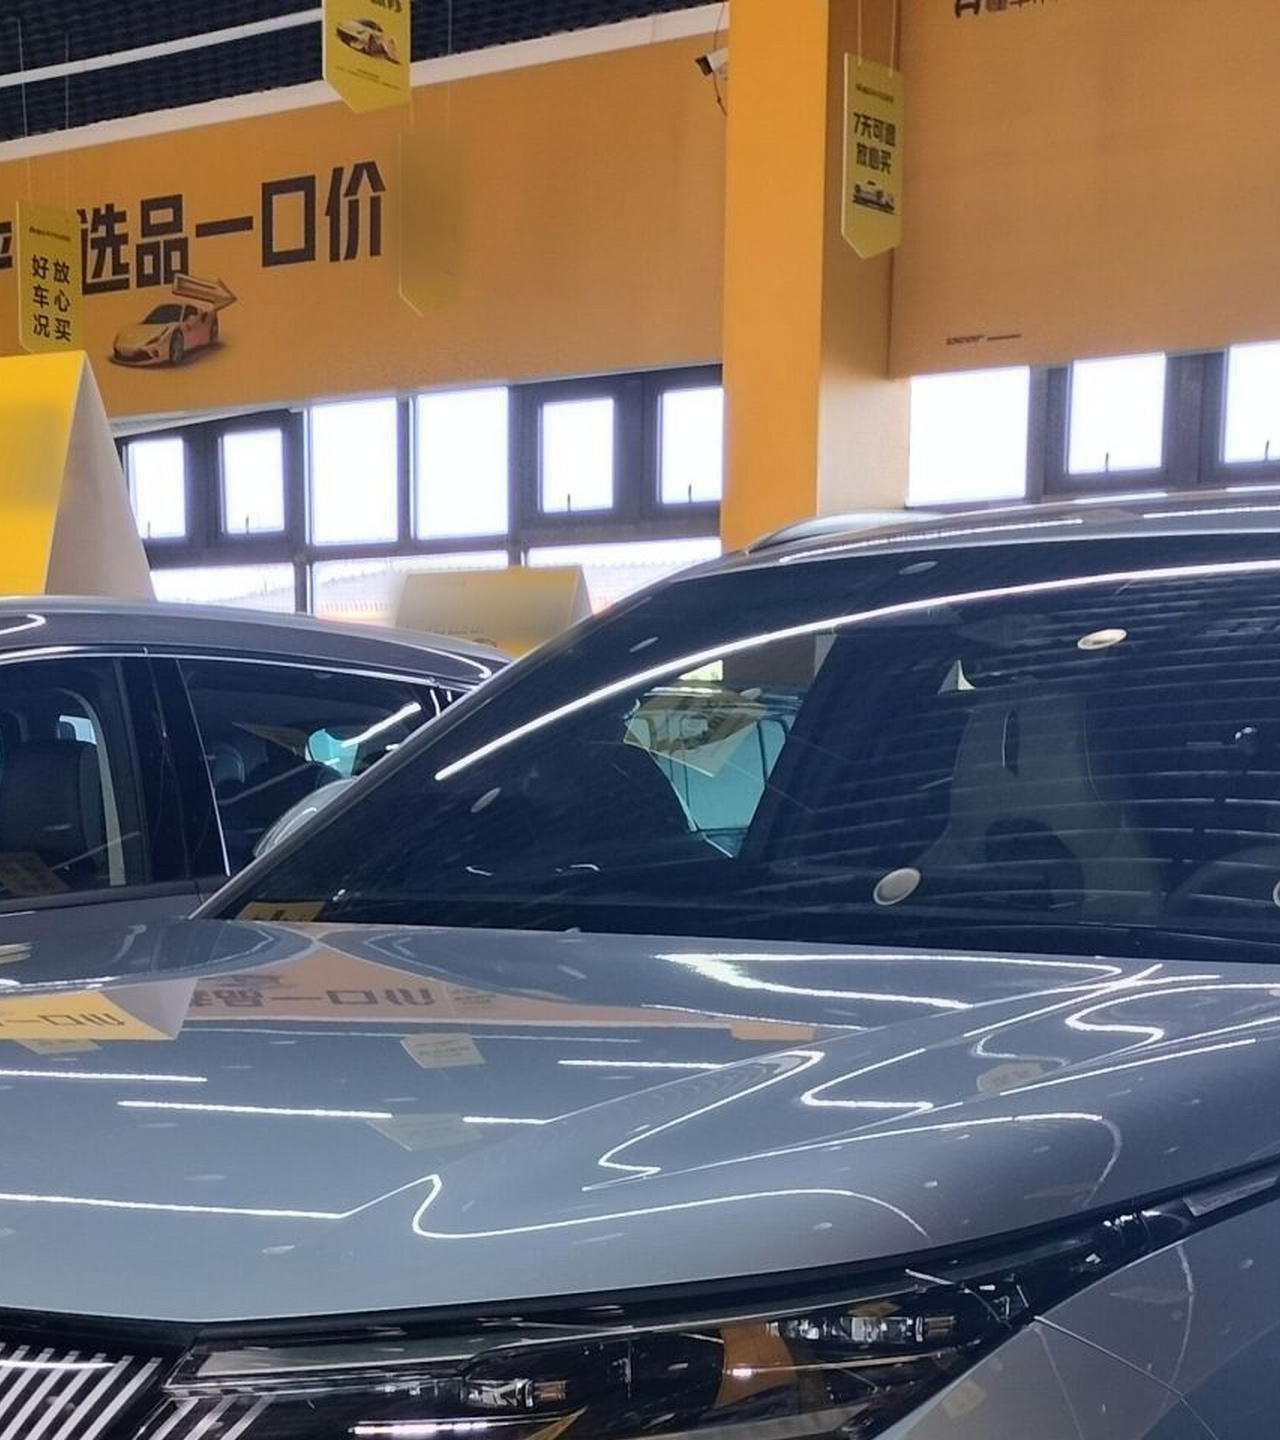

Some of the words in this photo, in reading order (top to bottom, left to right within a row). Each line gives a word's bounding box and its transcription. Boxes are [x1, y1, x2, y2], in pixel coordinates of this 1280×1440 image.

[31, 253, 51, 339] 好车况
[52, 259, 73, 343] 放心买
